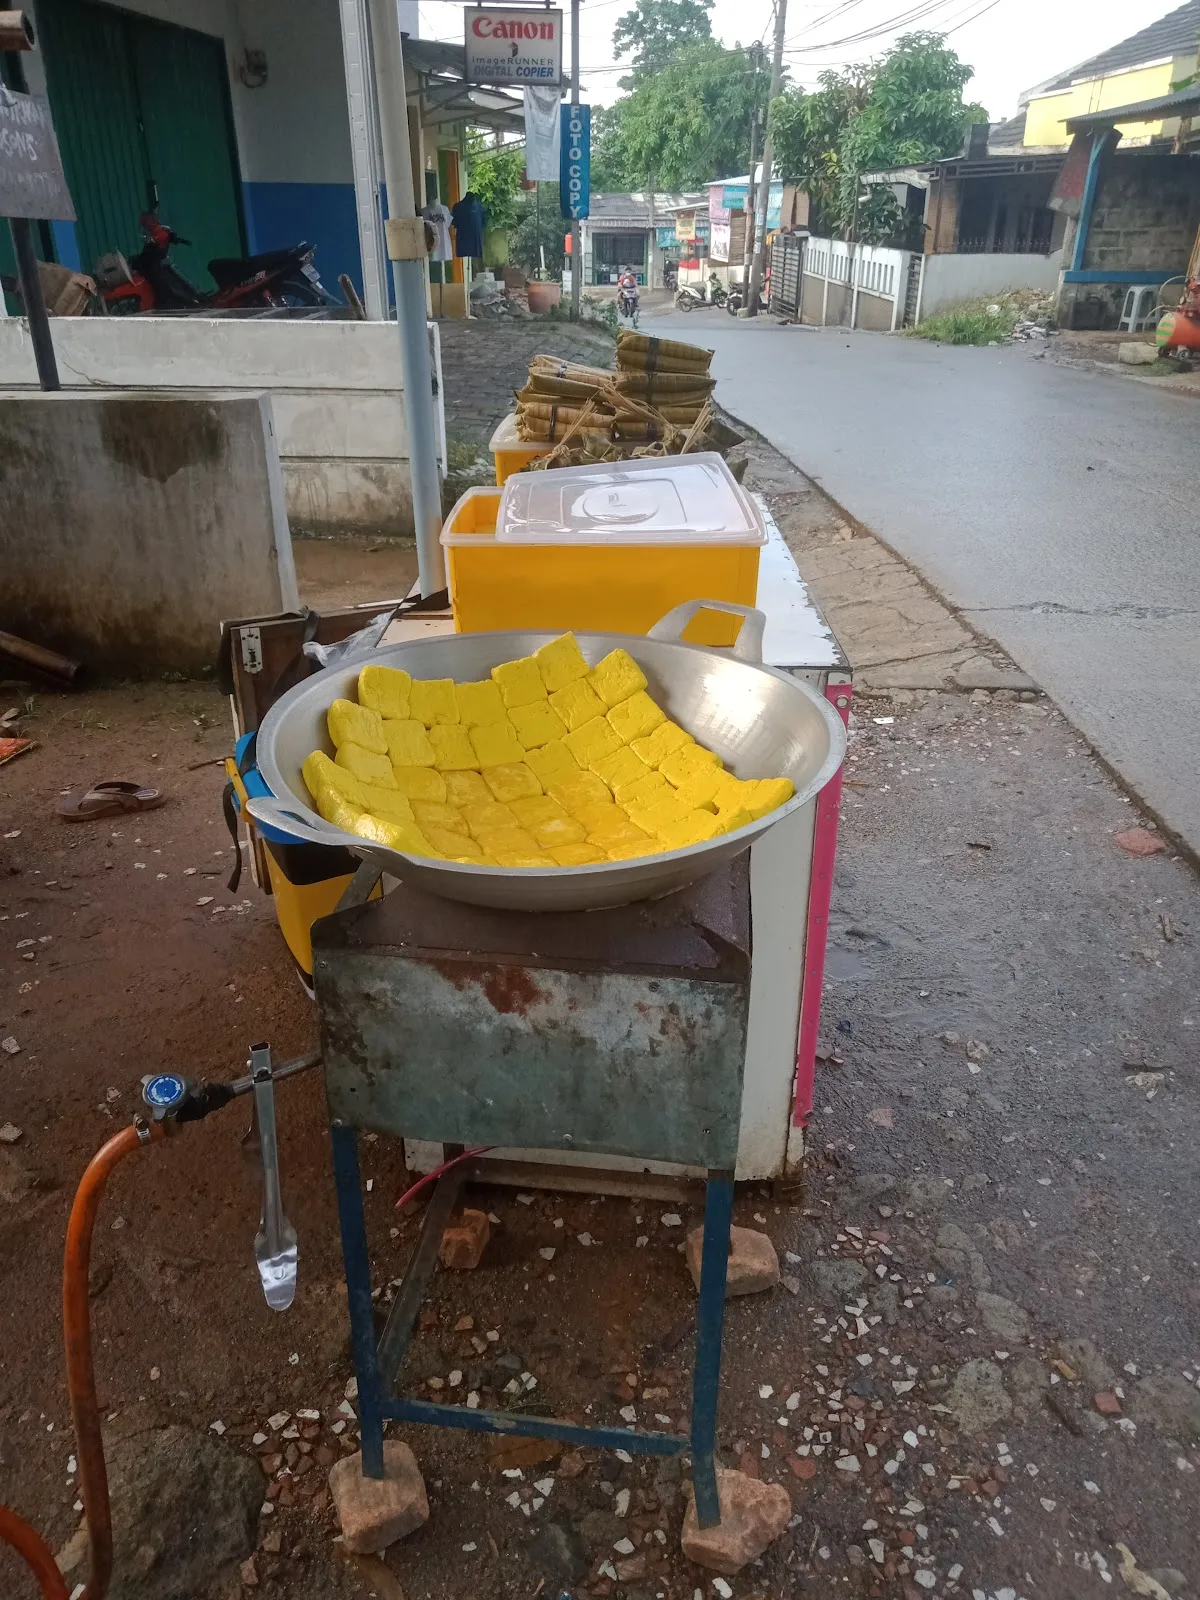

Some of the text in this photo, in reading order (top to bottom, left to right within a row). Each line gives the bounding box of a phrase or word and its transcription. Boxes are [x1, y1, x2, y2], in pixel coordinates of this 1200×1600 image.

[472, 16, 554, 39] Canon
[472, 56, 554, 65] imageRUNNER
[474, 65, 554, 77] DIGITAL COPIER
[569, 106, 582, 218] FOTO COPY
